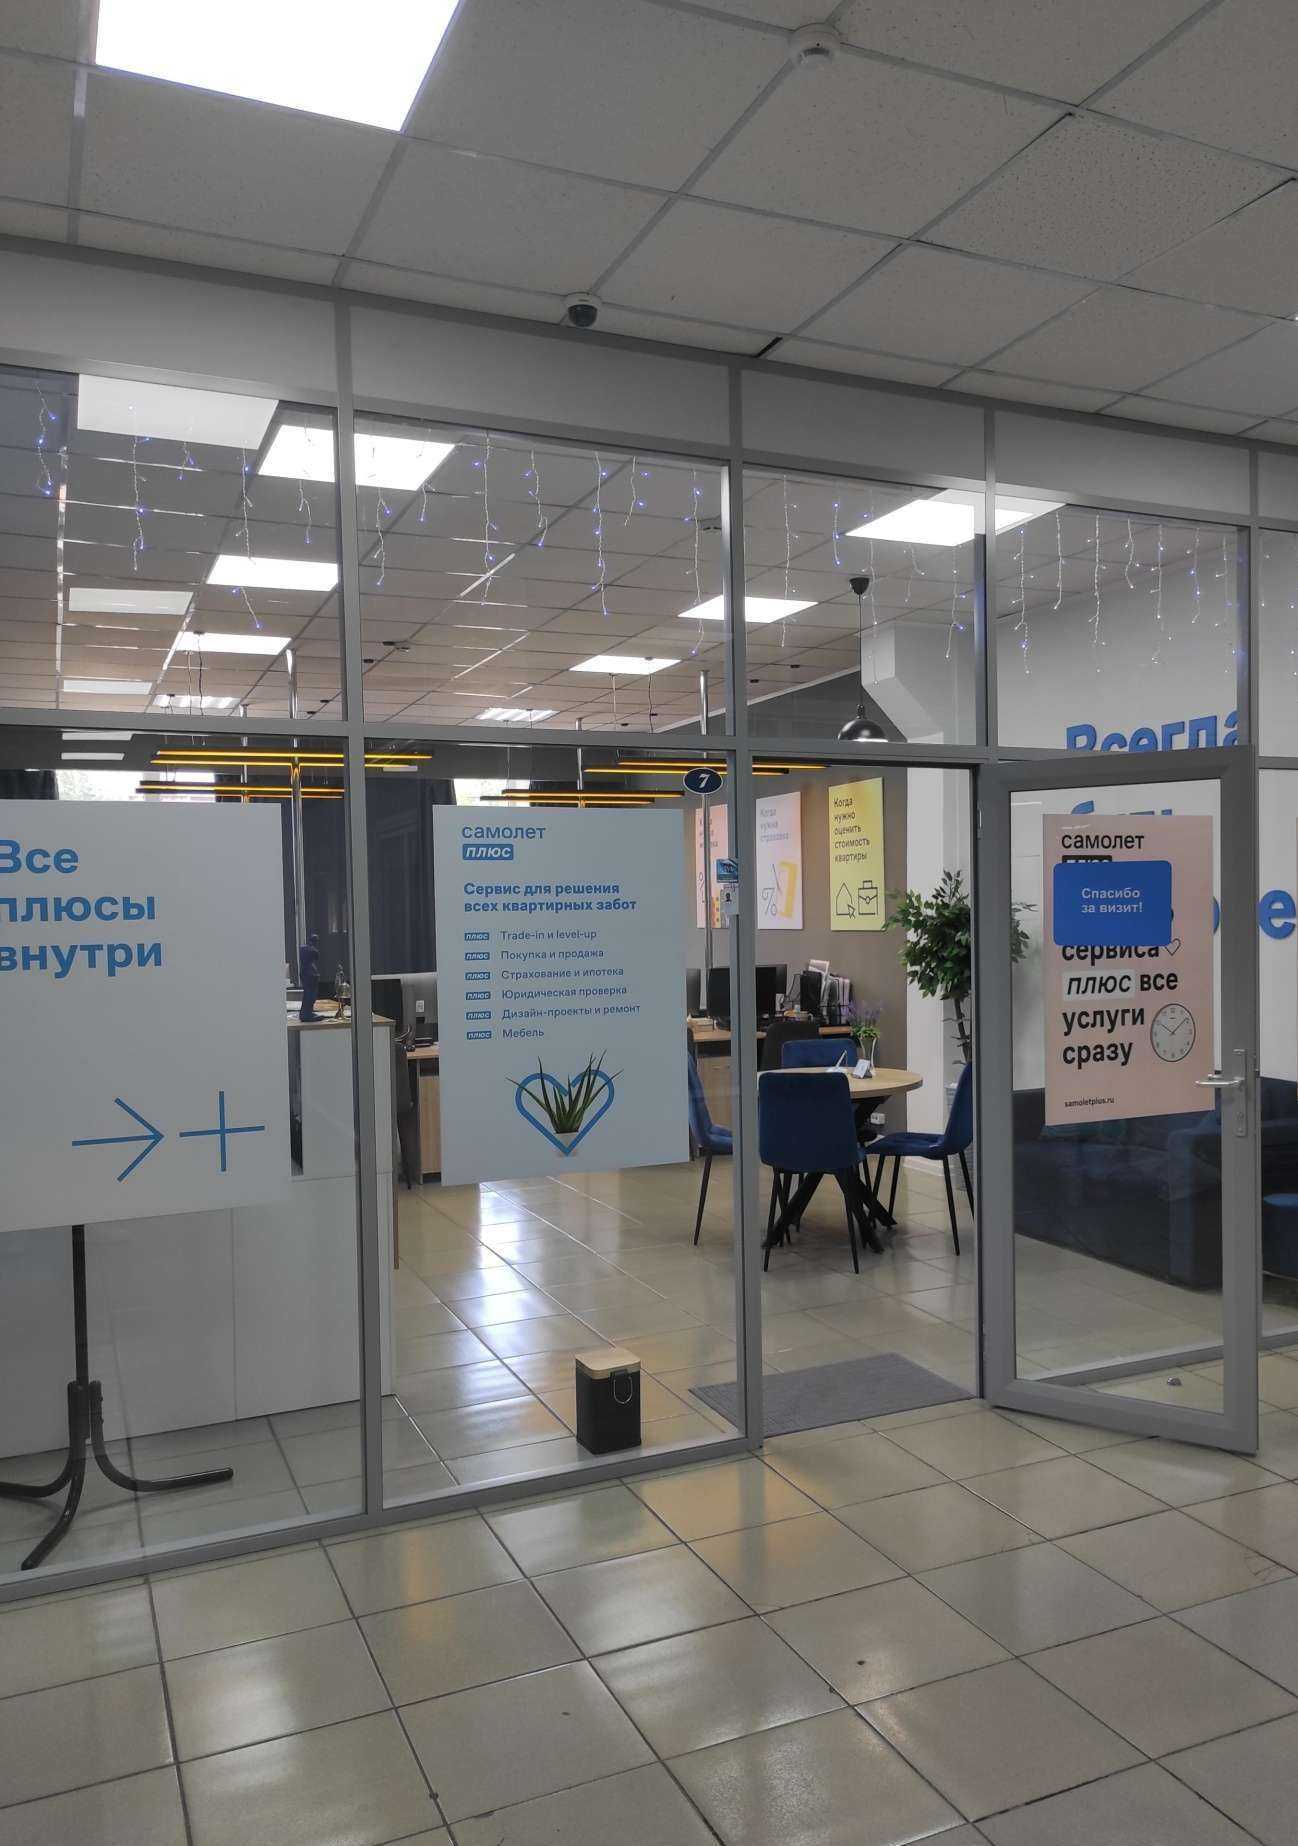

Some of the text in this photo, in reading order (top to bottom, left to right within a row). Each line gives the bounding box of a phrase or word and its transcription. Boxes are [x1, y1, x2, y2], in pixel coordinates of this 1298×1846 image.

[699, 774, 710, 788] 7
[462, 826, 546, 840] самолет
[834, 838, 870, 848] стоимость
[1062, 834, 1144, 849] самолет
[0, 840, 79, 874] Все
[464, 846, 512, 858] плюс
[464, 882, 620, 897] Сервис для решения
[1082, 887, 1140, 899] Спасибо
[0, 896, 156, 922] плюсы
[464, 898, 636, 914] всех квартирных забот
[1082, 902, 1143, 913] за визит!
[500, 930, 545, 940] Trade-in
[556, 930, 597, 940] level-up
[0, 943, 162, 979] внутри
[501, 950, 546, 961] Покупка
[559, 950, 604, 959] продажа
[1062, 944, 1159, 966] сервиса
[501, 970, 572, 981] Страхование
[583, 968, 624, 977] ипотека
[1067, 972, 1178, 995] плюс все
[466, 987, 627, 1000] плюс Юридическая проверка
[502, 1006, 592, 1020] Дизайн-проекты
[604, 1005, 641, 1015] ремонт
[1062, 1008, 1145, 1036] услуги
[467, 1028, 544, 1040] плюс Мебель
[1062, 1042, 1133, 1069] сразу
[1065, 1097, 1114, 1107] samoletplus.ru
